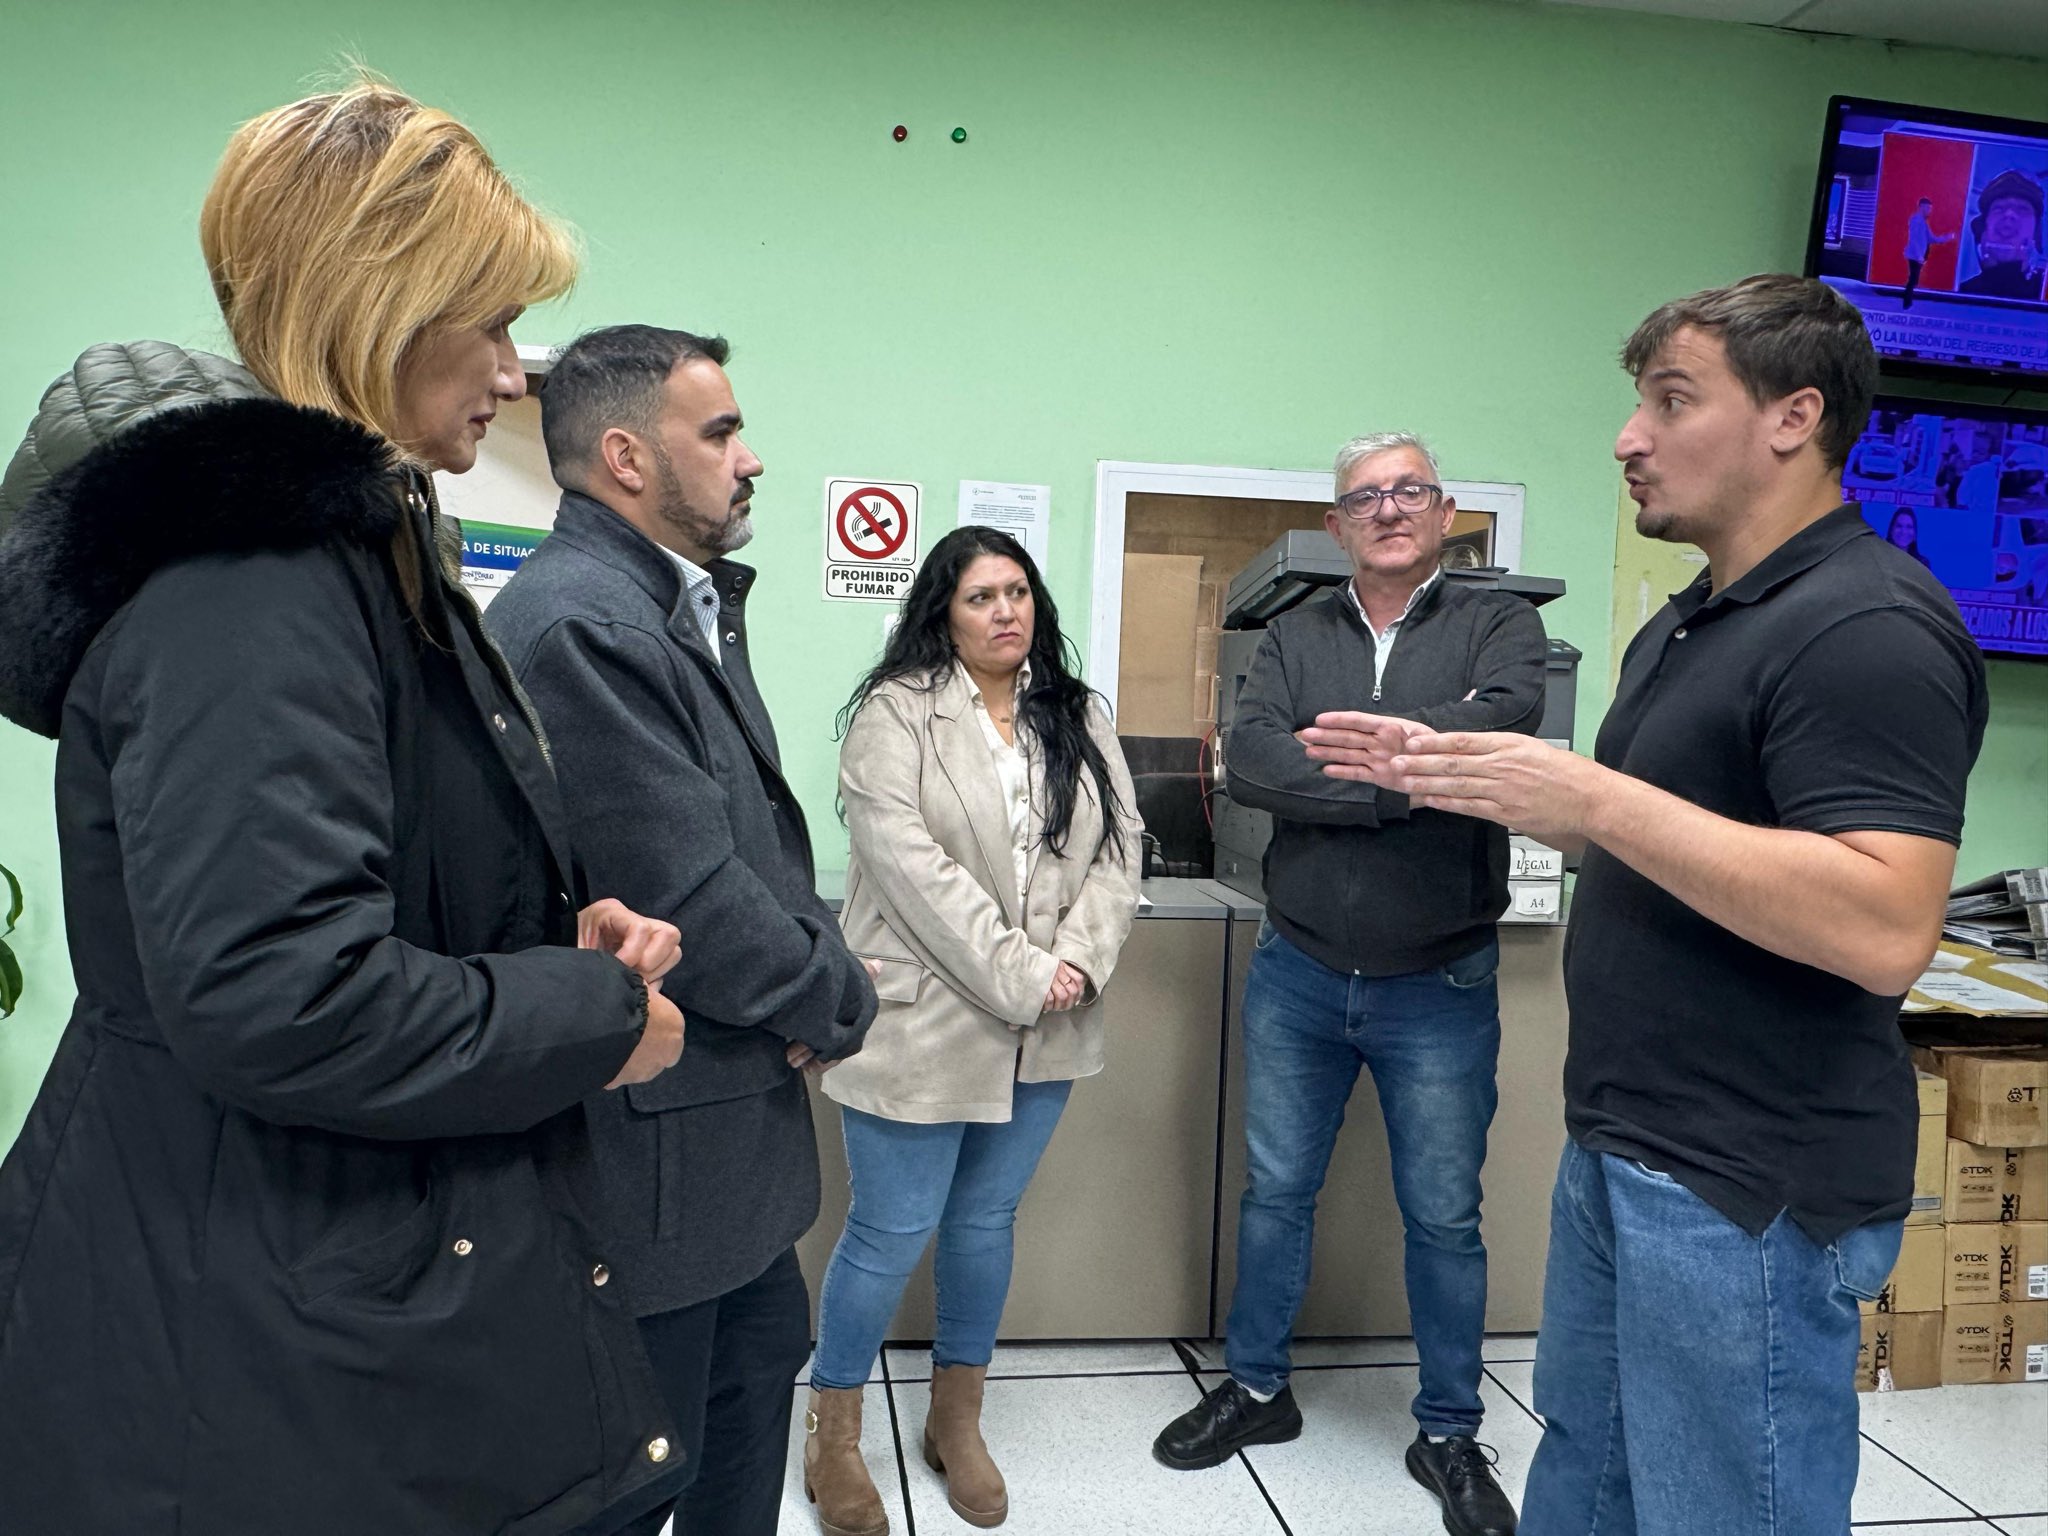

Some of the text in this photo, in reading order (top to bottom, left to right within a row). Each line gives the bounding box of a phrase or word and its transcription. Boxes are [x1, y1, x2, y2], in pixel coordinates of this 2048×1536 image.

[1884, 331, 1898, 343] LA
[1899, 331, 1942, 347] ILUSIÓN
[1944, 337, 1965, 350] DEL
[1966, 340, 2018, 356] REGRESO
[2020, 345, 2035, 357] DE
[474, 542, 491, 554] DE
[832, 569, 909, 583] PROHIBIDO
[846, 583, 895, 595] FUMAR
[2012, 610, 2023, 639] A
[1516, 860, 1552, 870] LEGAL
[1530, 898, 1545, 908] A4
[1967, 1166, 1993, 1174] TDK
[1963, 1254, 1989, 1262] TDK
[2000, 1244, 2012, 1290] TDK
[1964, 1326, 1990, 1334] TDK
[1874, 1331, 1888, 1376] TDK
[2000, 1327, 2013, 1373] TDK
